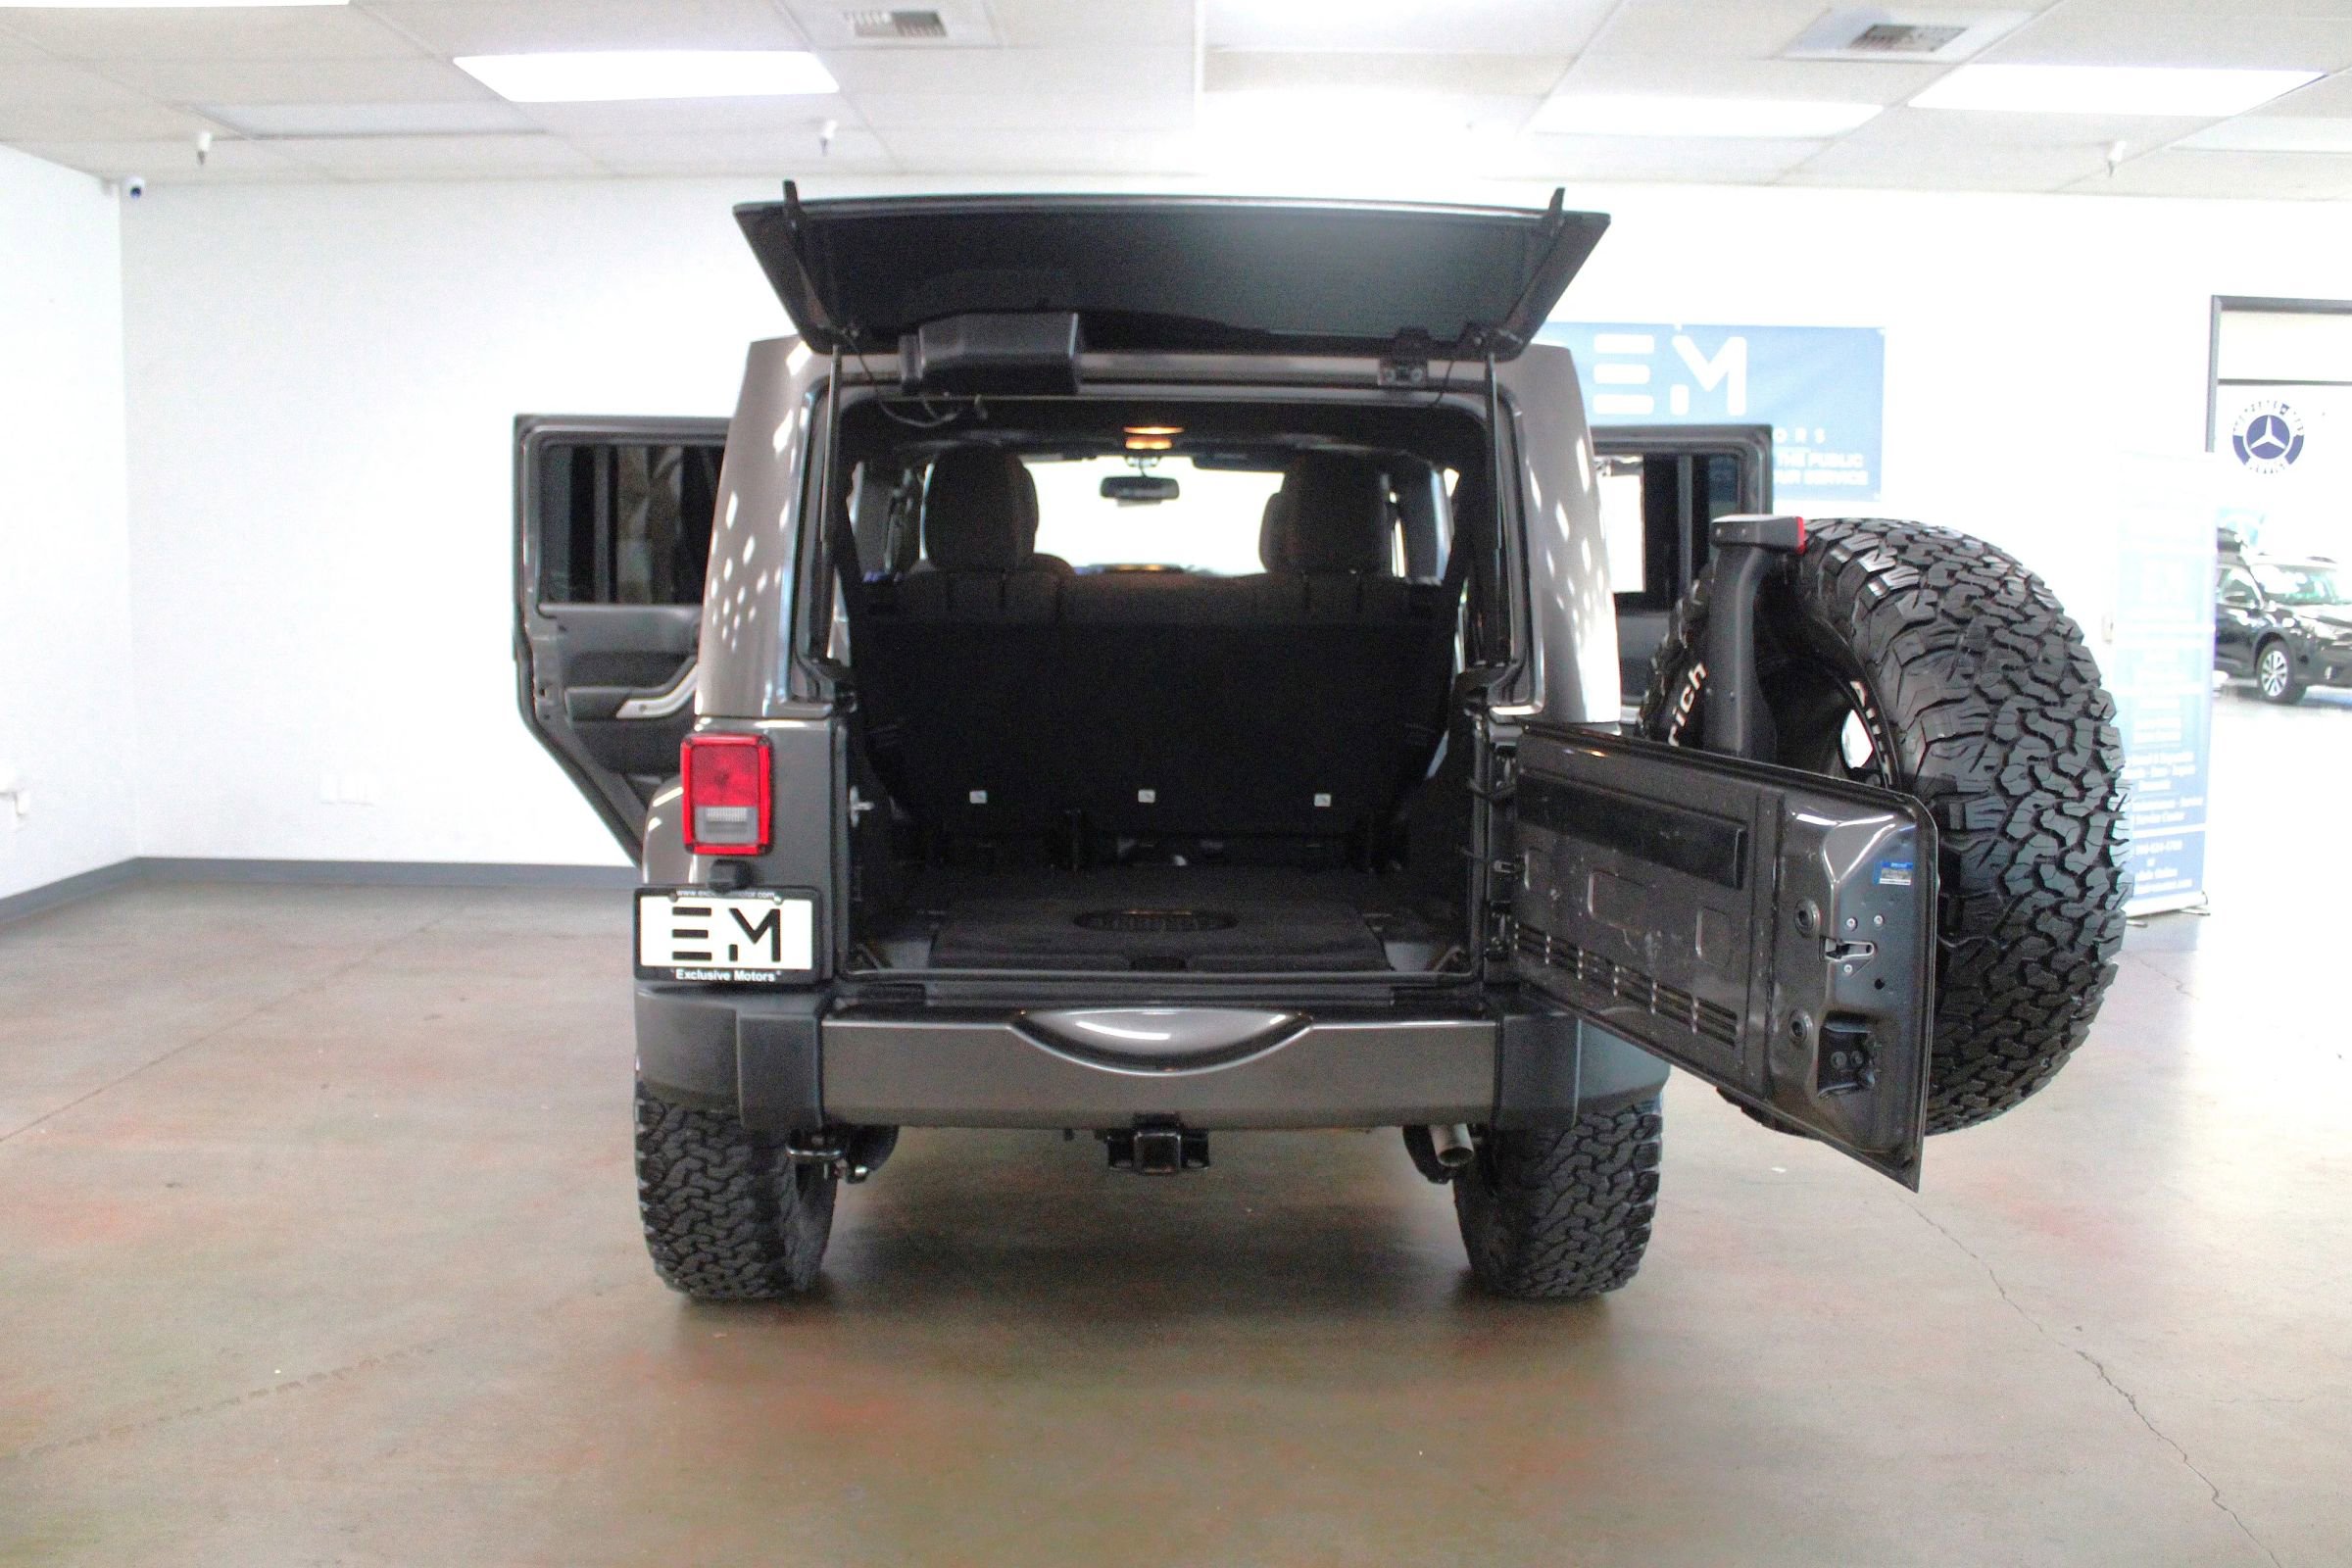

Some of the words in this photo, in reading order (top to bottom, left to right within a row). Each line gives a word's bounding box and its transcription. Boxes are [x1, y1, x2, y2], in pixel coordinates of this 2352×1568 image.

[672, 906, 781, 962] EM
[675, 968, 731, 981] Exclusive
[733, 969, 776, 983] Motors
